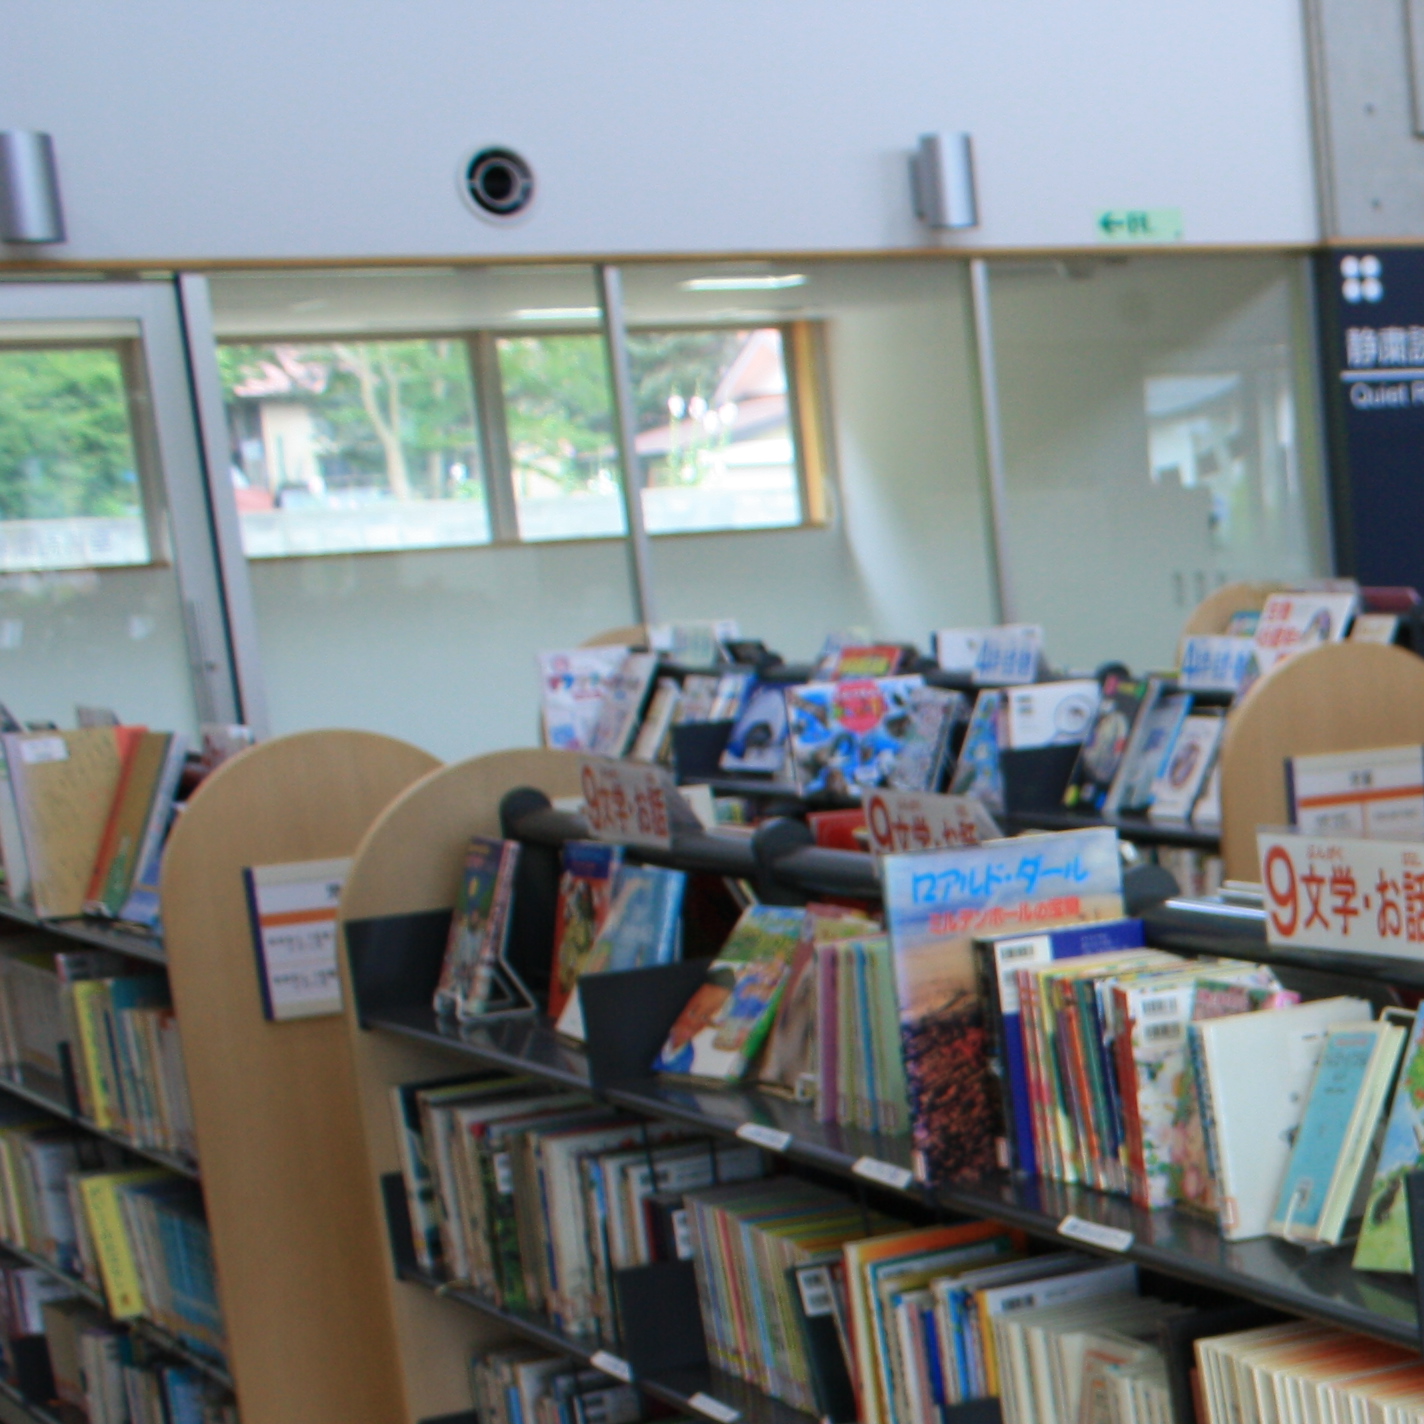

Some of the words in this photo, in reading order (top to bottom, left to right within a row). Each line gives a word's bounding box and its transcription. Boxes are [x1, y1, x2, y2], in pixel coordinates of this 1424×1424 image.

[1350, 381, 1409, 409] Quiet
[912, 854, 1090, 903] ロアルド・ダール
